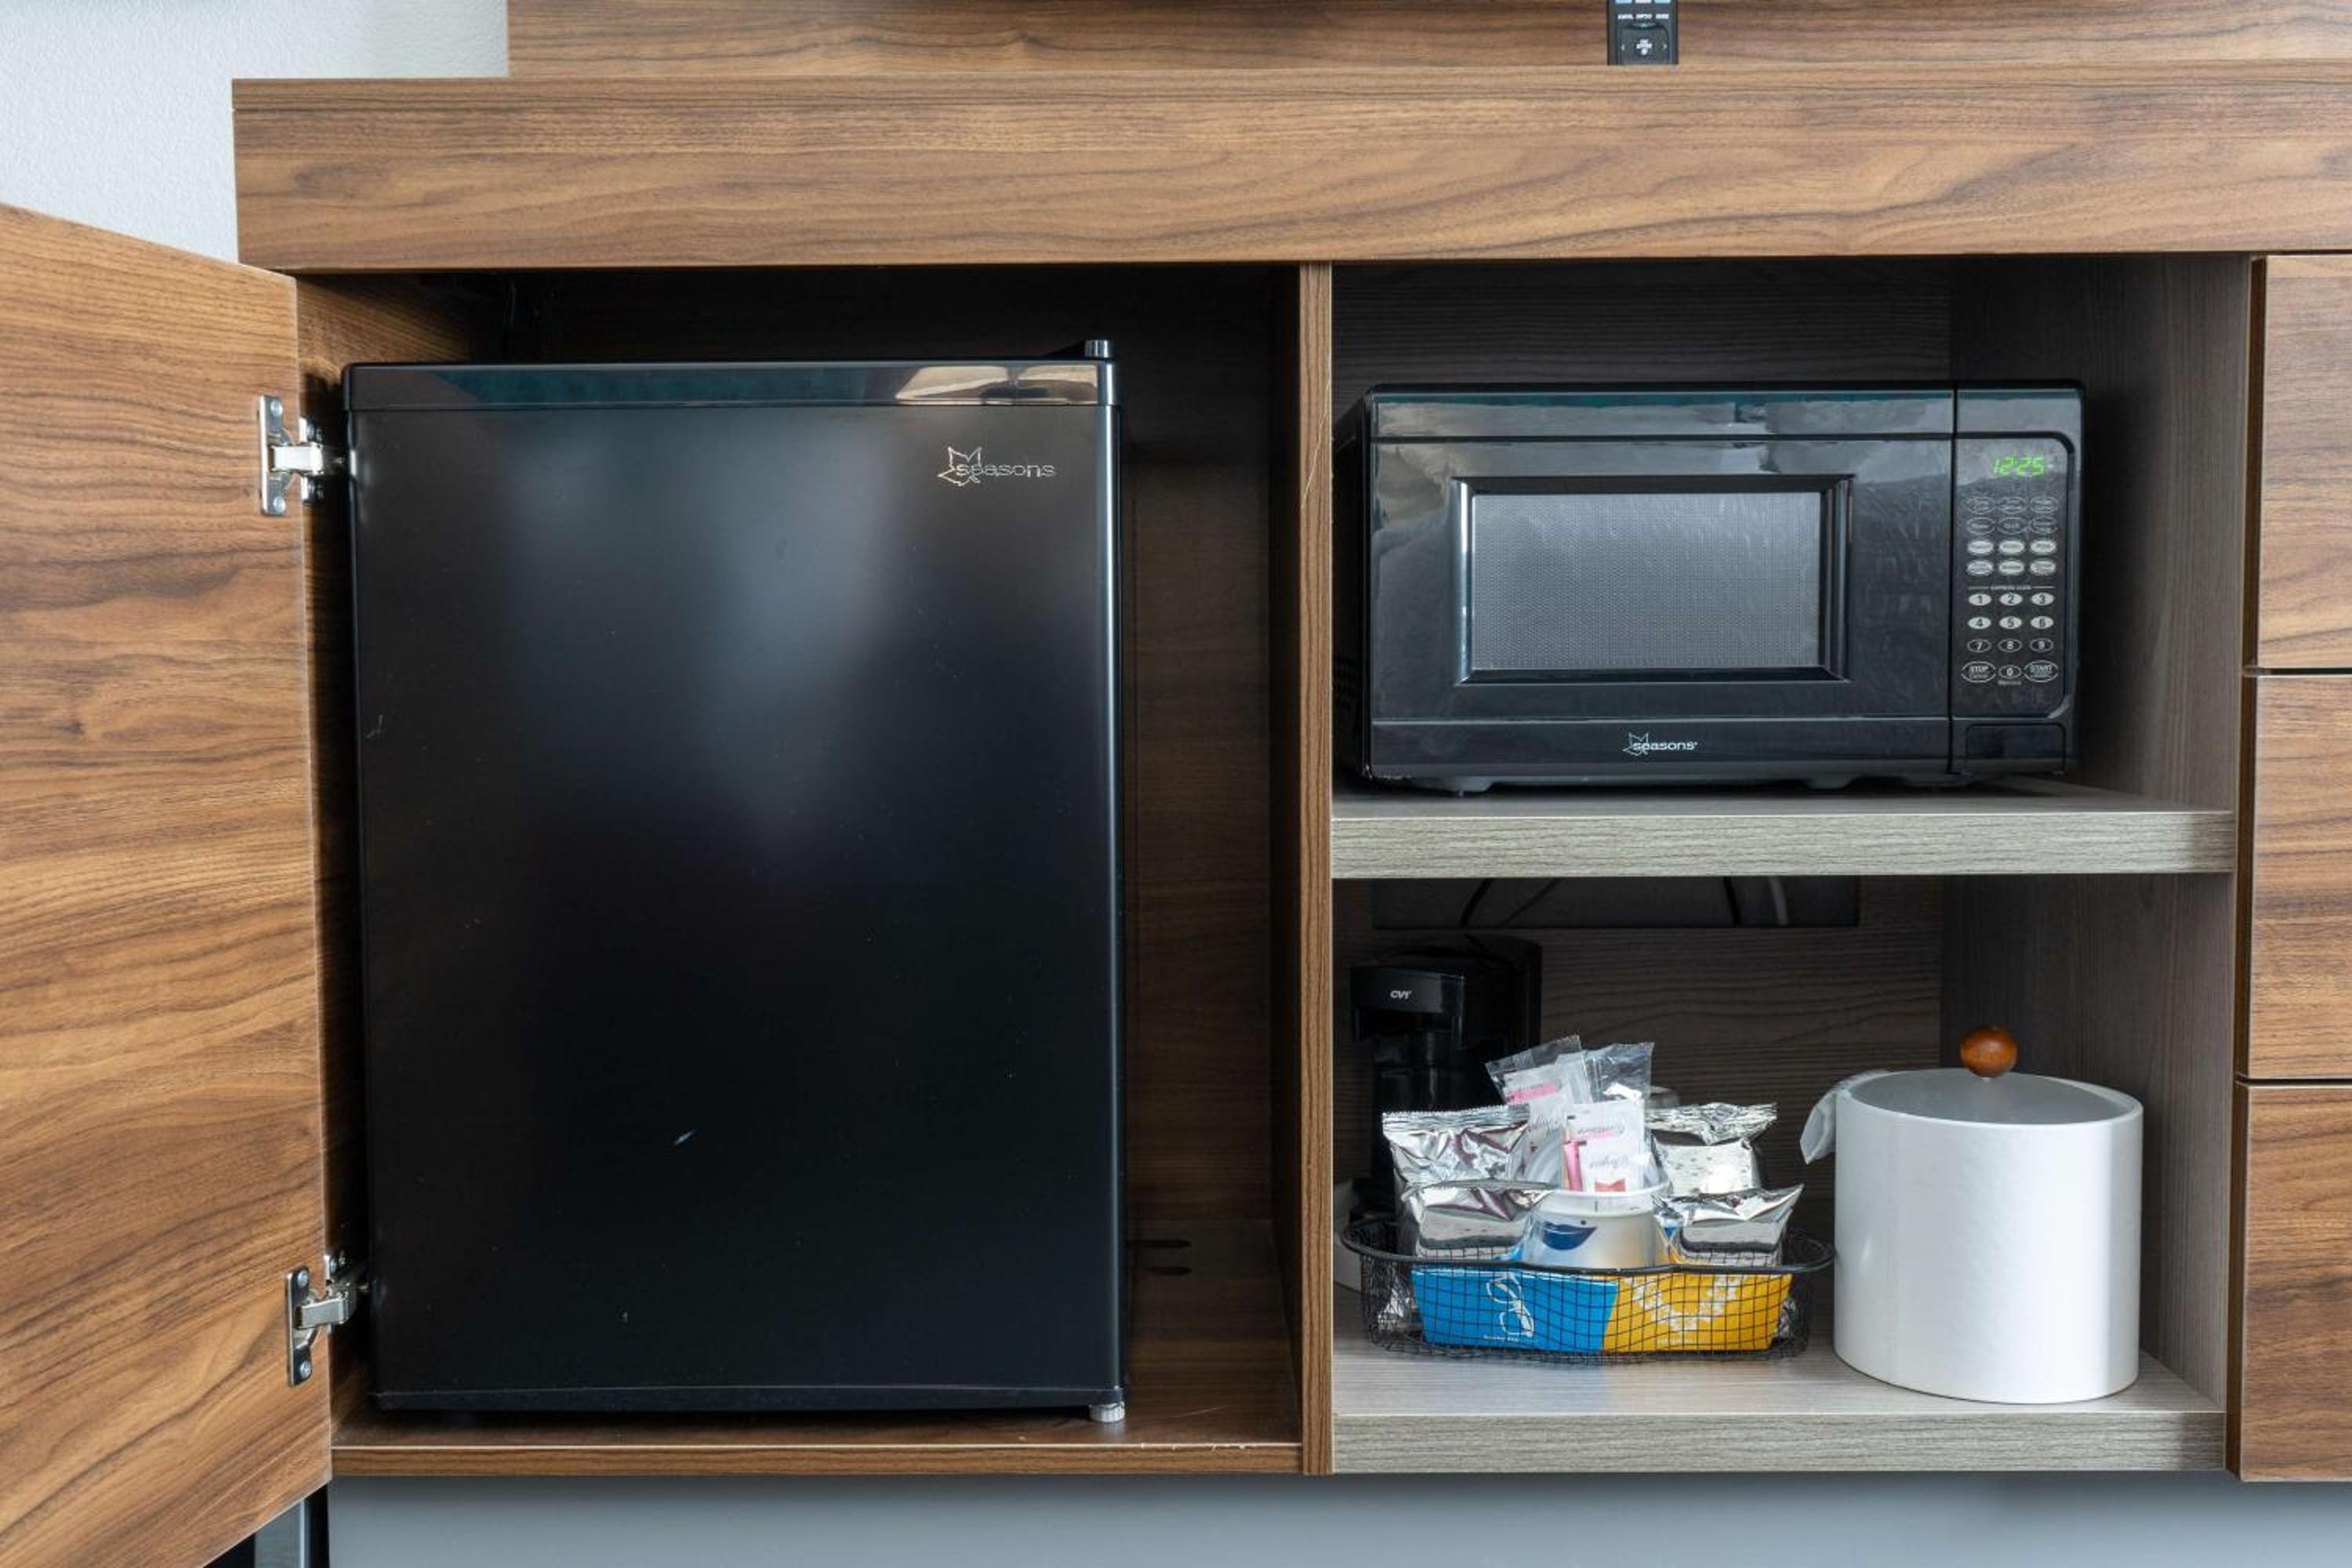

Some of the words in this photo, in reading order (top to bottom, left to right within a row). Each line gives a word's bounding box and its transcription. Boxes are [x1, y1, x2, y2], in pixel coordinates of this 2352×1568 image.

[956, 463, 1056, 477] seasons
[1977, 595, 1983, 604] 1
[2008, 594, 2014, 604] 2
[2039, 594, 2045, 604] 3
[1976, 618, 1983, 627] 4
[2007, 617, 2014, 627] 5
[2040, 618, 2045, 627] 6
[1976, 641, 1983, 651] 7
[2007, 641, 2013, 649] 8
[2039, 641, 2045, 650] 9
[2007, 667, 2013, 676] 0
[1633, 741, 1695, 750] seasons
